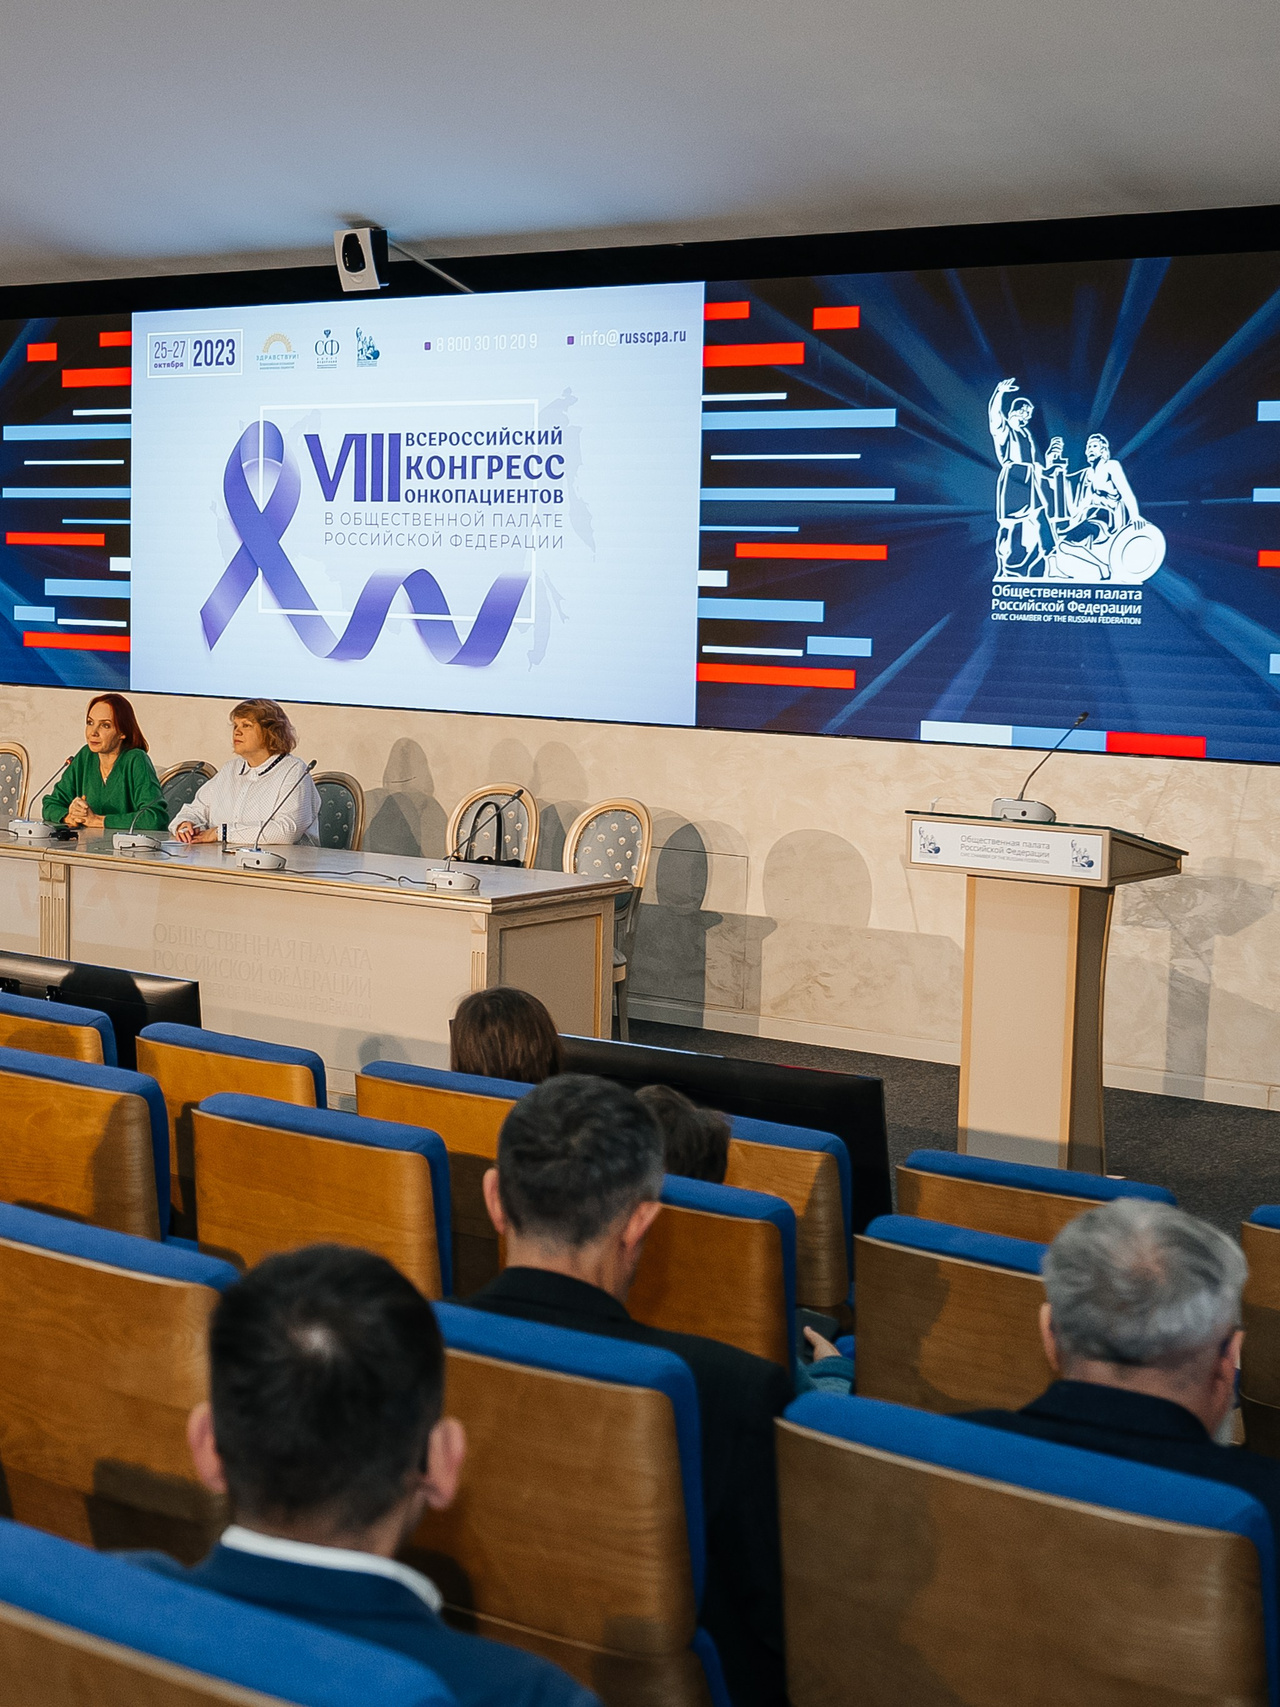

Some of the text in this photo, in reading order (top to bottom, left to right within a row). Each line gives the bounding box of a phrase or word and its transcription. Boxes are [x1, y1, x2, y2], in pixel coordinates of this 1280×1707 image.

[436, 332, 538, 352] 8 800 30 10 20 9
[579, 329, 687, 347] info@russcpa.ru
[193, 338, 236, 367] 2023
[315, 339, 340, 356] СФ
[153, 360, 184, 370] октября
[405, 426, 563, 447] ВСЕРОССИЙСКИЙ
[303, 432, 402, 503] VIII
[405, 454, 565, 480] КОНГРЕСС
[404, 488, 564, 506] ОНКОПАЦИЕНТОВ
[324, 510, 563, 528] В ОБЩЕСТВЕННОЙ ПАЛАТЕ
[324, 530, 563, 551] РОССИЙСКОЙ ФЕДЕРАЦИИ
[992, 584, 1142, 600] Общественная палата
[991, 599, 1142, 616] Российской Федерации
[991, 613, 1008, 621] CIVIC
[1009, 613, 1042, 622] CHAMBER
[1053, 615, 1067, 623] THE
[1068, 616, 1097, 624] RUSSIAN
[1098, 616, 1142, 625] FEDERATION
[960, 834, 1050, 850] Общественная палата
[960, 843, 1050, 858] Российской Федерации
[152, 922, 373, 970] ОБЩЕСТВЕННАЯ ПАЛАТА
[152, 948, 372, 999] РОССИЙСКОЙ ФЕДЕРАЦИИ
